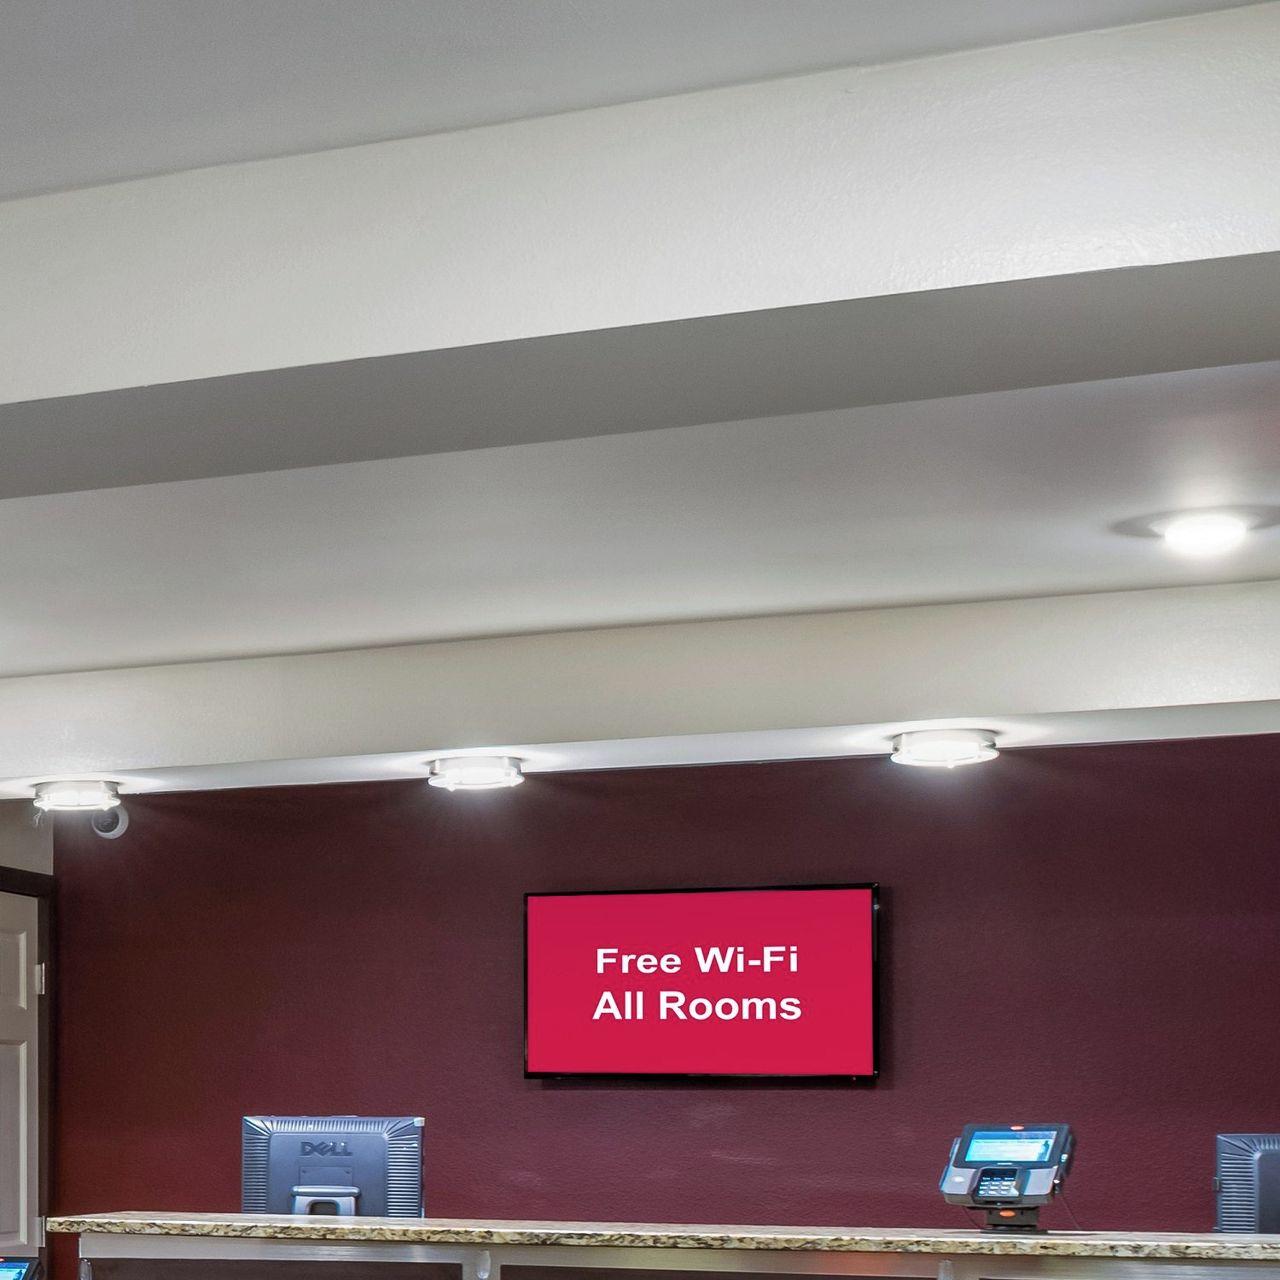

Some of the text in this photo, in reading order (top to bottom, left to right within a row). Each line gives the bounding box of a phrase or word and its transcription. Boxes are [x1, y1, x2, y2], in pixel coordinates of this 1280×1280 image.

[596, 945, 799, 974] Free Wi-Fi
[592, 990, 802, 1020] All Rooms
[300, 1141, 353, 1157] DELL
